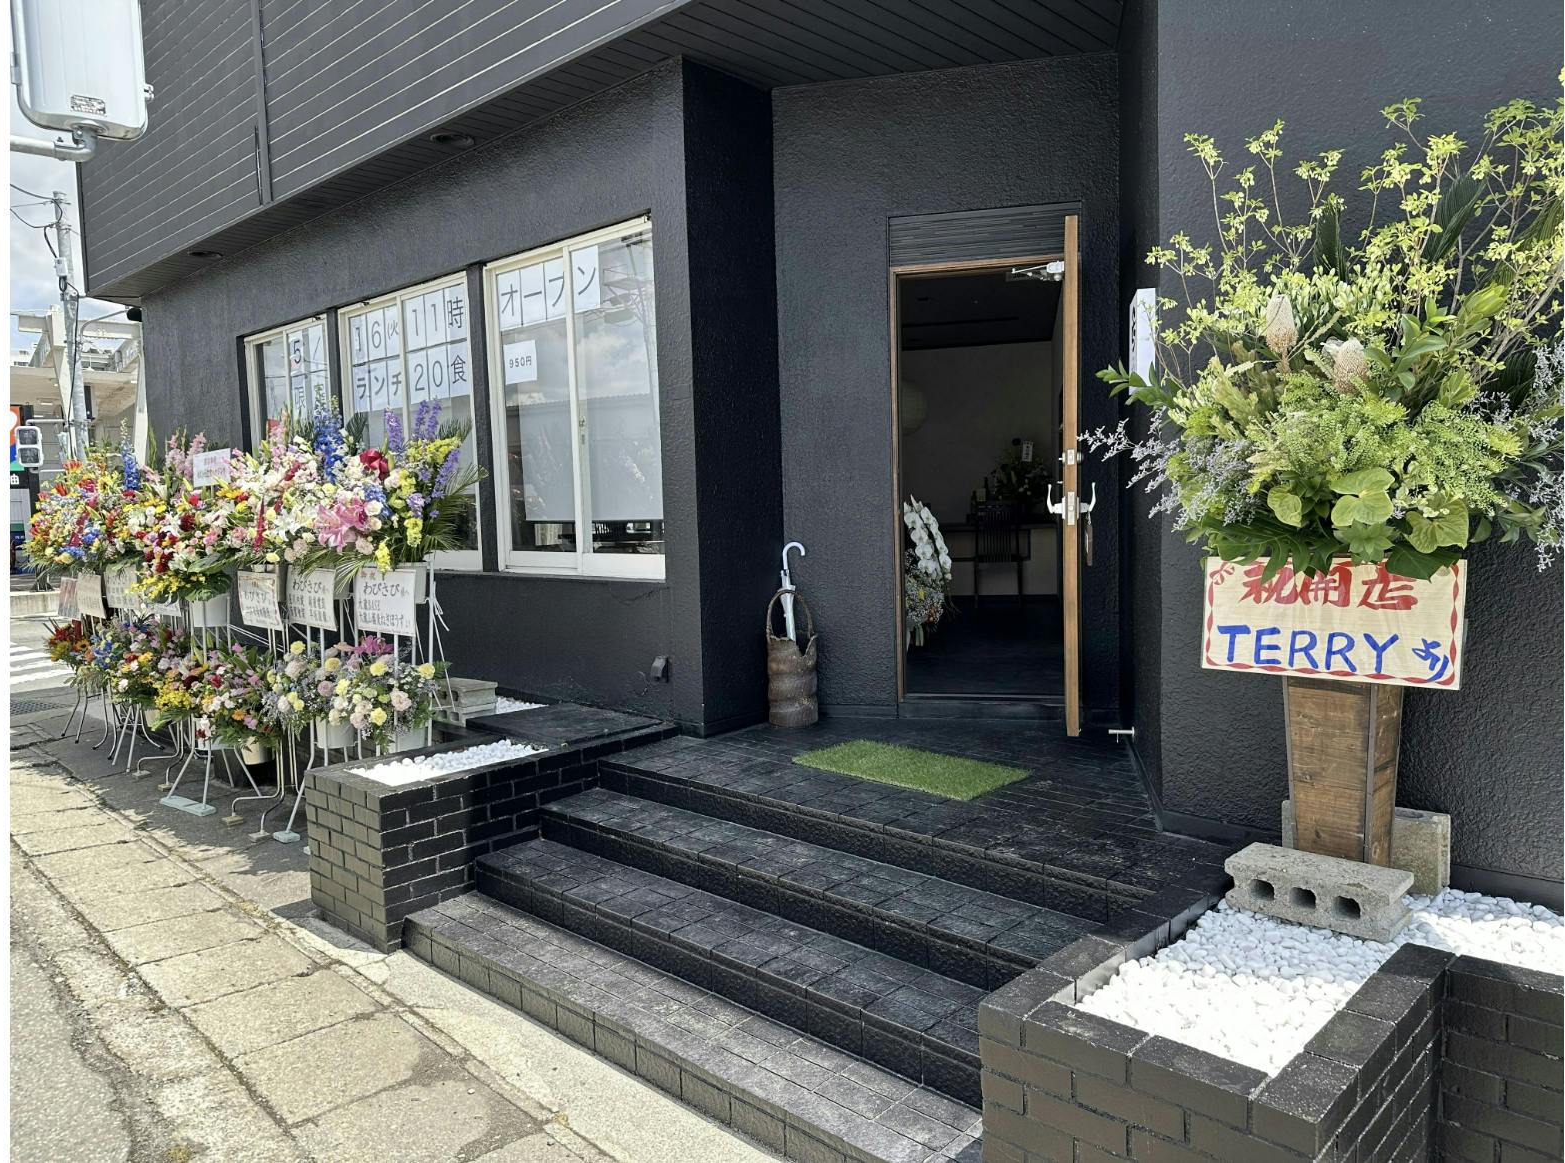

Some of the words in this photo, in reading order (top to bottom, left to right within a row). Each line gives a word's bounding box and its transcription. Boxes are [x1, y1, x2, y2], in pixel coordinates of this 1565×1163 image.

[356, 371, 402, 399] ランチ
[414, 354, 467, 392] 20食
[508, 355, 532, 369] 950円
[363, 582, 400, 597] わびさび
[1217, 624, 1400, 674] TERRY
